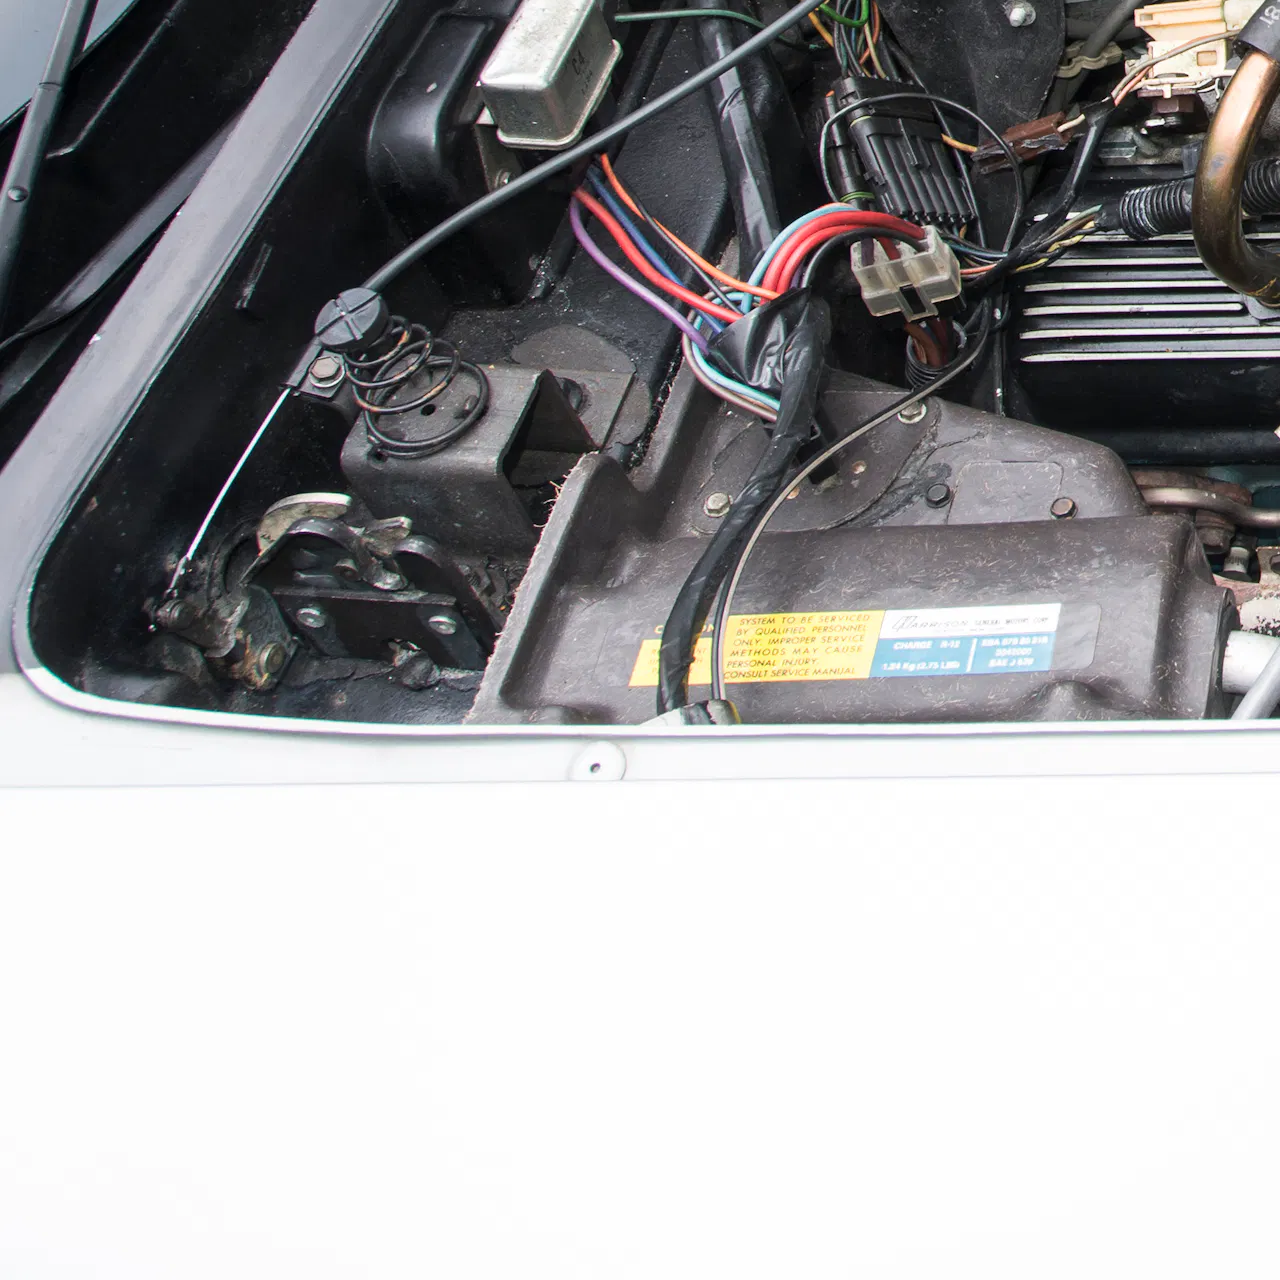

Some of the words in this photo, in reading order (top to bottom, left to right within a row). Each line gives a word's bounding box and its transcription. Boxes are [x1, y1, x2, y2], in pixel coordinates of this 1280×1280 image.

[740, 617, 775, 625] SYSTEM
[818, 614, 870, 623] SERVICED
[755, 626, 805, 635] QUALIFIED
[812, 624, 867, 632] PERSONNEL
[768, 637, 816, 645] IMPROPER
[893, 640, 933, 650] CHARGE
[726, 660, 777, 668] PERSONAL
[724, 670, 768, 679] CONSULT
[771, 669, 809, 677] SERVICE
[812, 667, 856, 675] MANUAL
